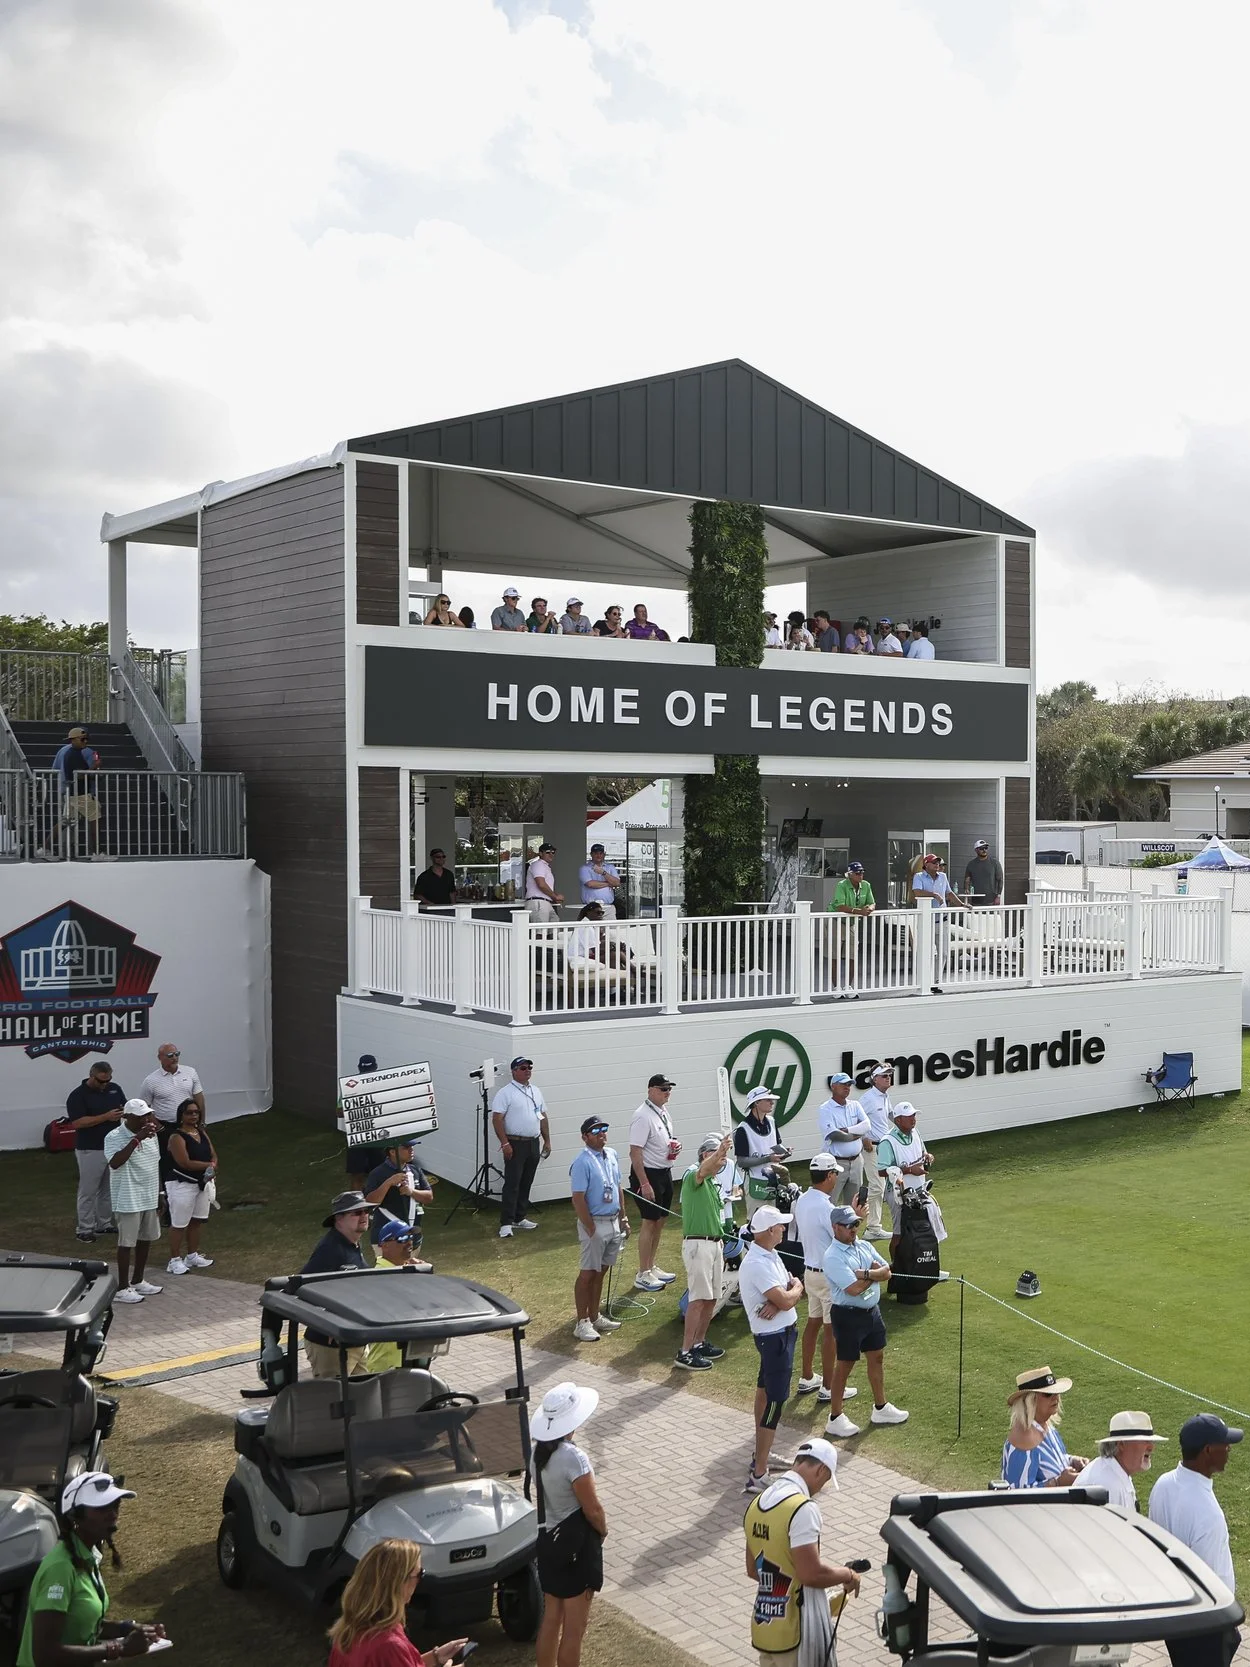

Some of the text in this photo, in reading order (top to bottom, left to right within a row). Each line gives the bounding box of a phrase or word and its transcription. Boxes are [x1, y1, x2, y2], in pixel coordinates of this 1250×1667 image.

[487, 682, 954, 737] HOME OF LEGENDS
[614, 820, 624, 829] The
[0, 997, 149, 1012] RO FOOTBALL
[0, 1010, 143, 1040] HALL OF FAME
[81, 1040, 107, 1048] OHIO
[827, 1029, 1106, 1090] JamesHardie
[360, 1067, 426, 1085] TEKNOR APEX
[344, 1084, 431, 1110] O'NEAL 1
[348, 1095, 434, 1121] QUIGLEY 2
[349, 1119, 437, 1146] ALLEN 9
[350, 1108, 436, 1133] PRIDE 2
[760, 1602, 783, 1615] FAME
